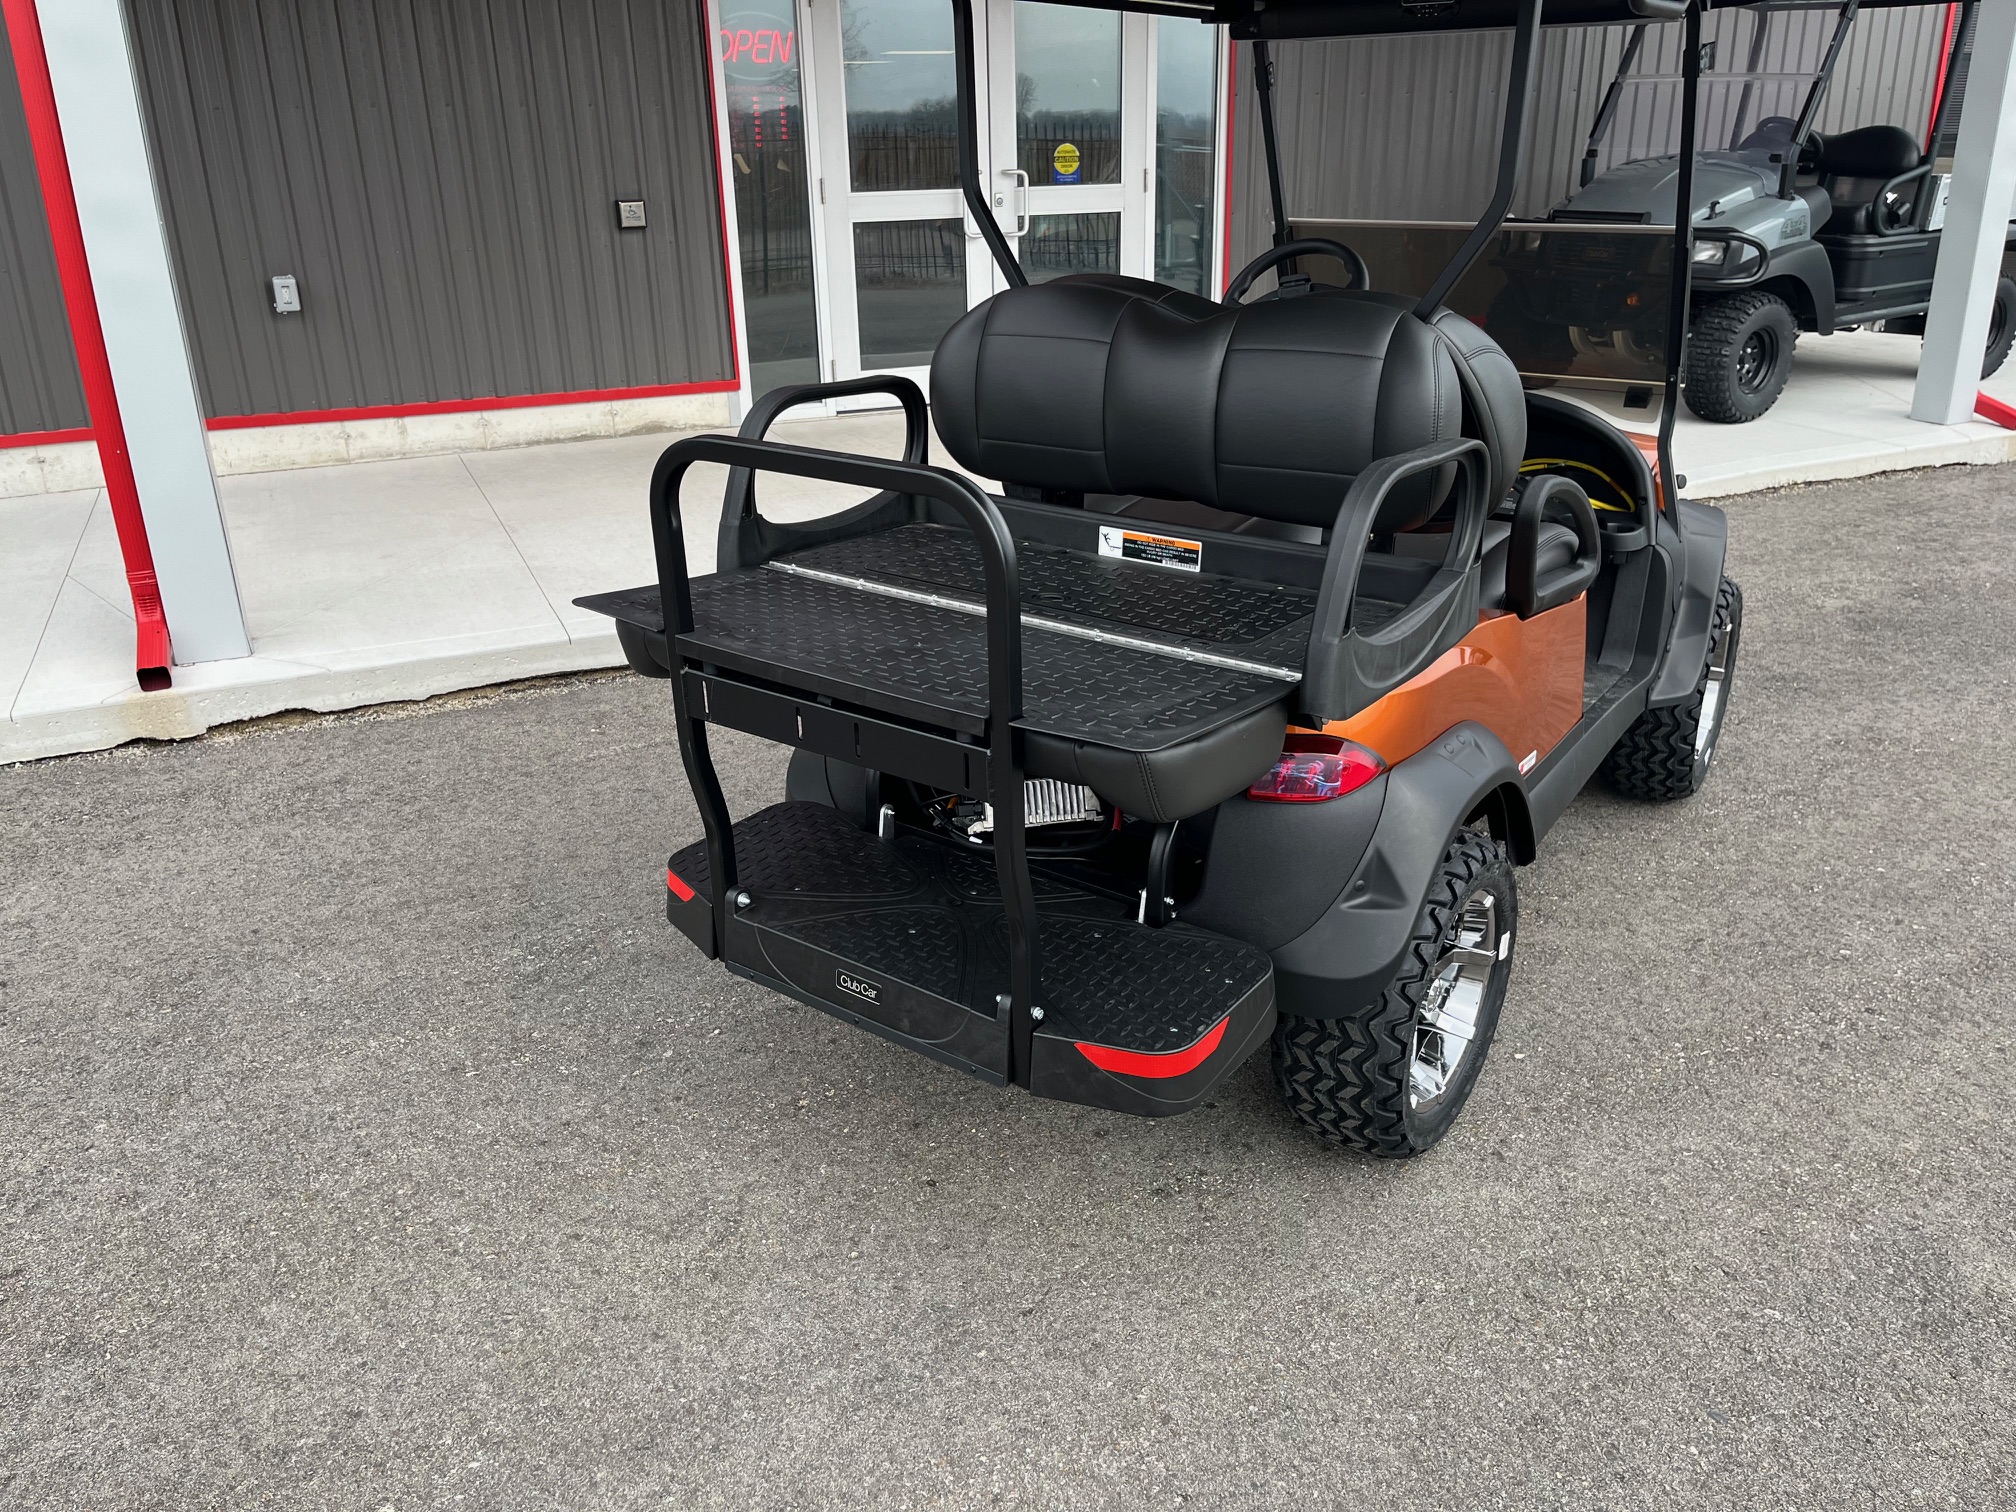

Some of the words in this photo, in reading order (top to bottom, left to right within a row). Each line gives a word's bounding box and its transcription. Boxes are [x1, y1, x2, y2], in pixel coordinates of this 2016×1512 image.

[720, 29, 793, 64] OPEN
[1151, 536, 1176, 547] WARNING
[840, 975, 861, 992] Club
[860, 983, 878, 999] Car
